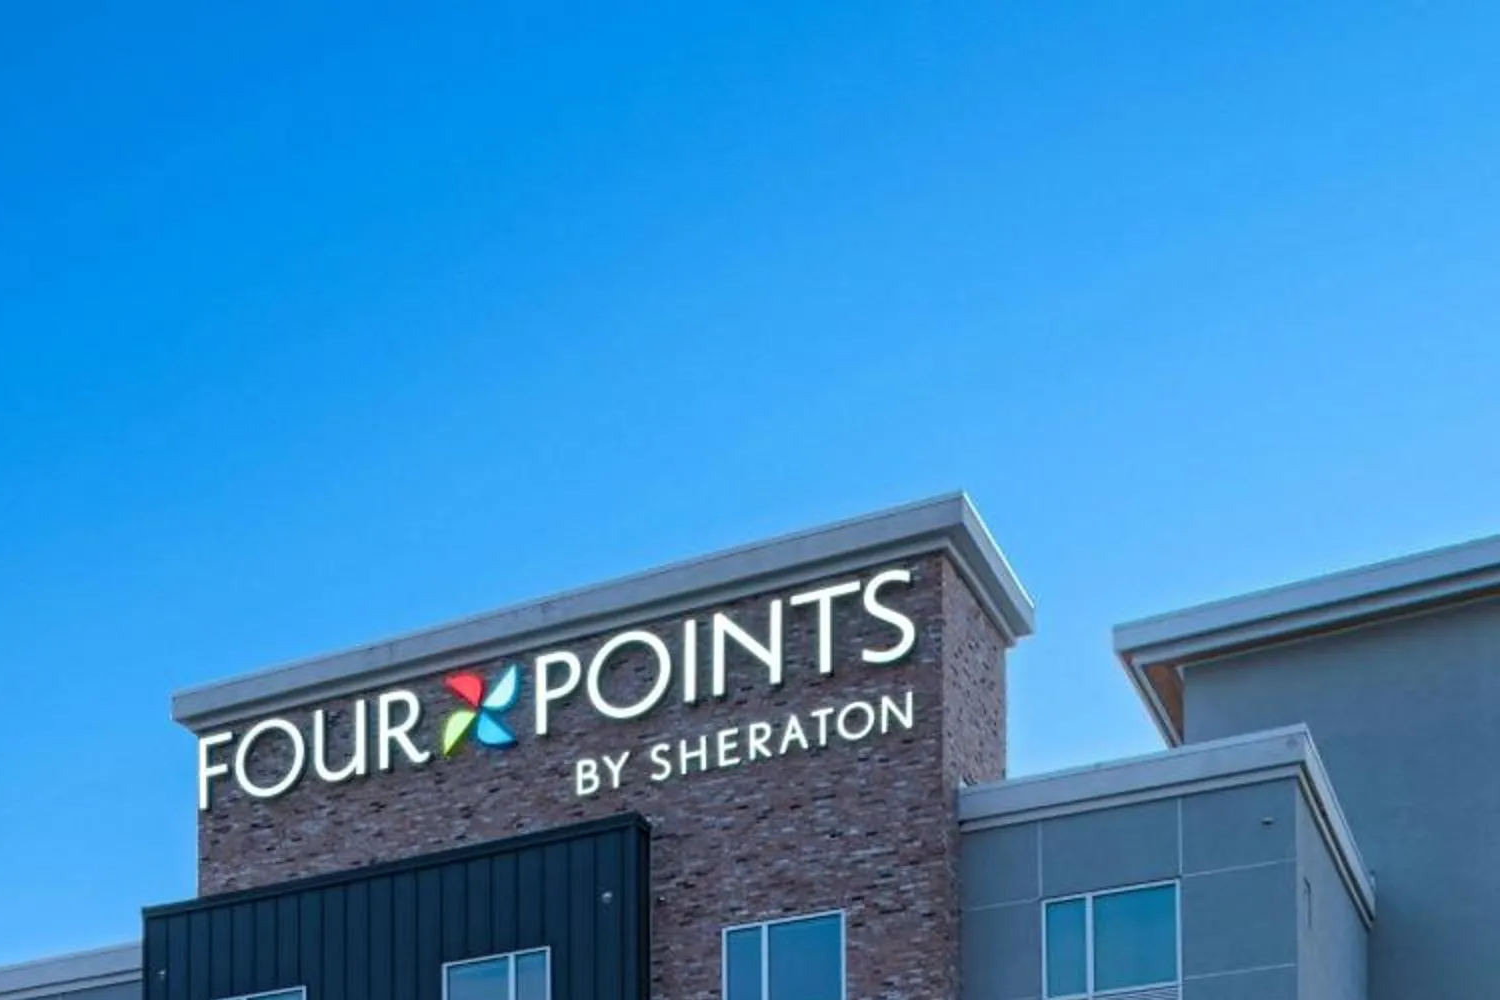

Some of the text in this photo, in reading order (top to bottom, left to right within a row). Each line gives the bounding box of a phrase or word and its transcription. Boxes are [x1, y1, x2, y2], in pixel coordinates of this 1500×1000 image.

[199, 569, 916, 810] FOUR POINTS
[576, 691, 913, 795] BY SHERATON
